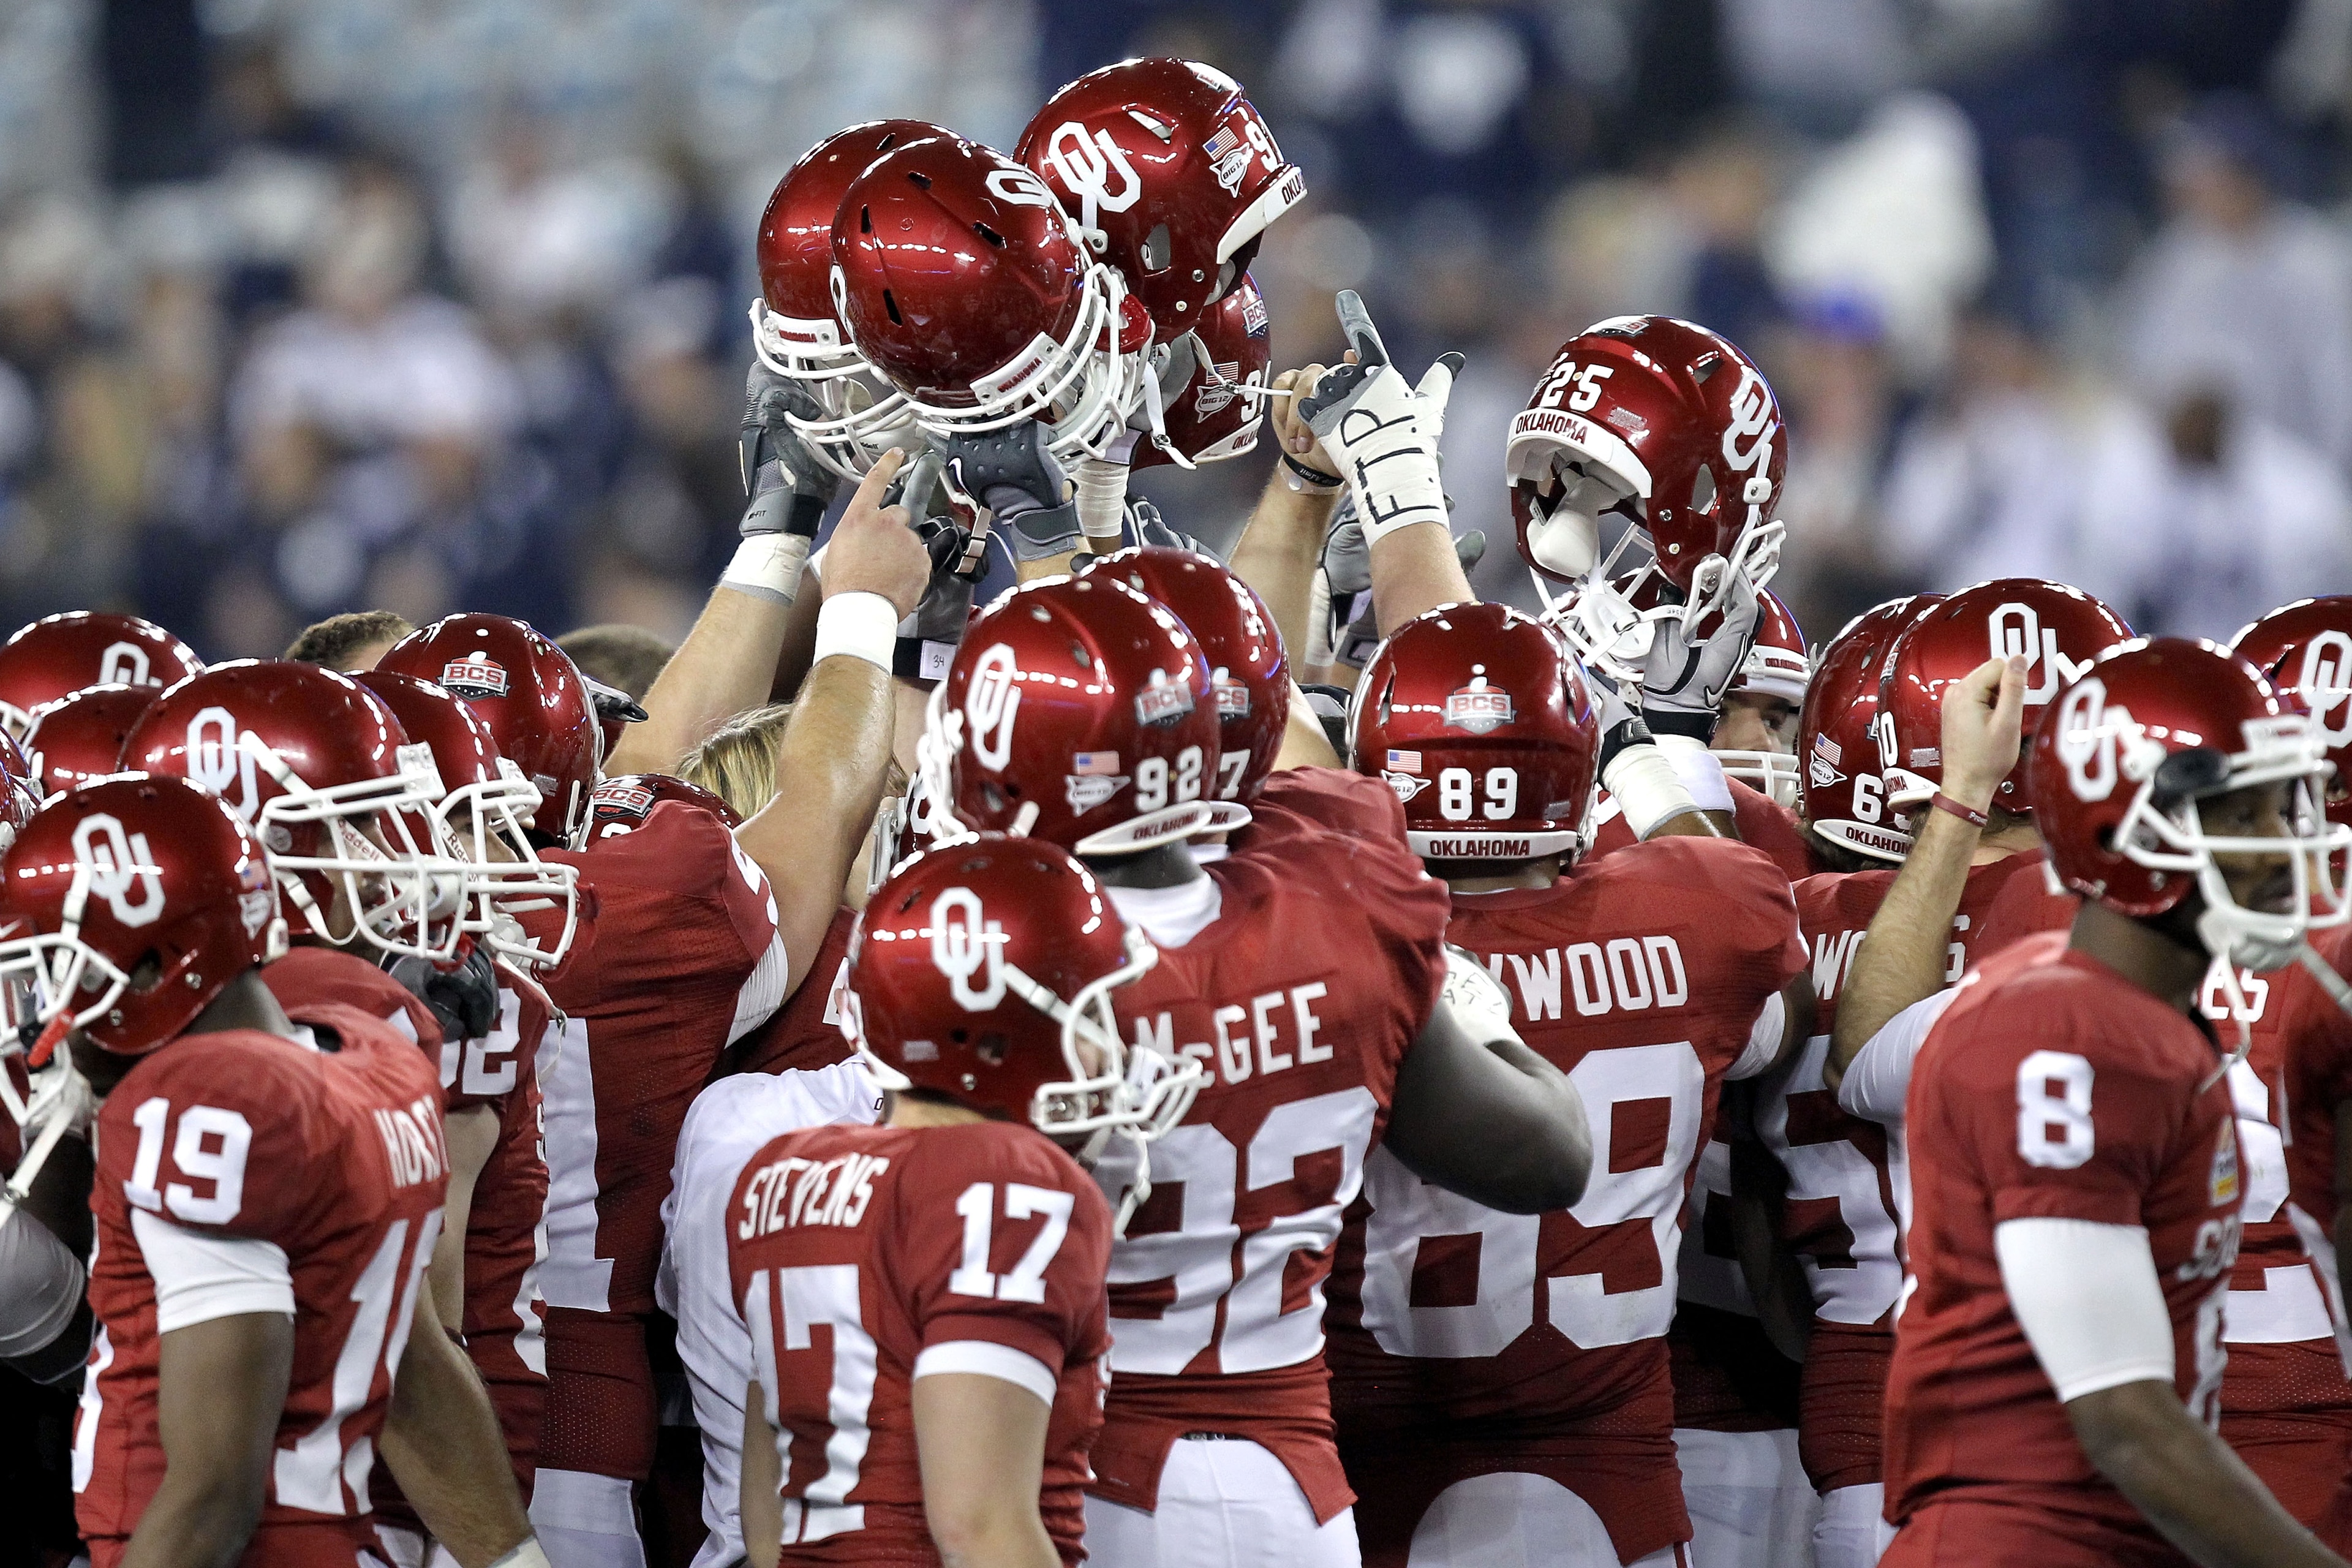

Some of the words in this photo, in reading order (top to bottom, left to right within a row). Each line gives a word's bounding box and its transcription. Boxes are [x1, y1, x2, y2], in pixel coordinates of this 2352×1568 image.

[1223, 166, 1237, 179] BIG
[1539, 361, 1614, 412] 25
[1515, 411, 1589, 445] OKLAHOMA
[447, 665, 503, 685] BCS
[933, 654, 945, 668] 34
[1989, 603, 2059, 705] OU
[1215, 690, 1245, 707] CS
[1453, 696, 1508, 712] BCS
[592, 788, 649, 806] BCS
[1135, 745, 1203, 813] 92
[1439, 767, 1518, 821] 89
[1811, 766, 1823, 776] BIG
[1823, 772, 1831, 781] 12
[1430, 840, 1530, 857] OKLAHOMA
[930, 887, 1008, 1012] OU
[2018, 1050, 2095, 1169] 8
[123, 1096, 253, 1224] 19
[739, 1152, 890, 1240] STEVENS
[1361, 1041, 1705, 1359] 89
[950, 1182, 1075, 1305] 17
[1091, 1085, 1380, 1376] 92
[745, 1264, 878, 1545] 17
